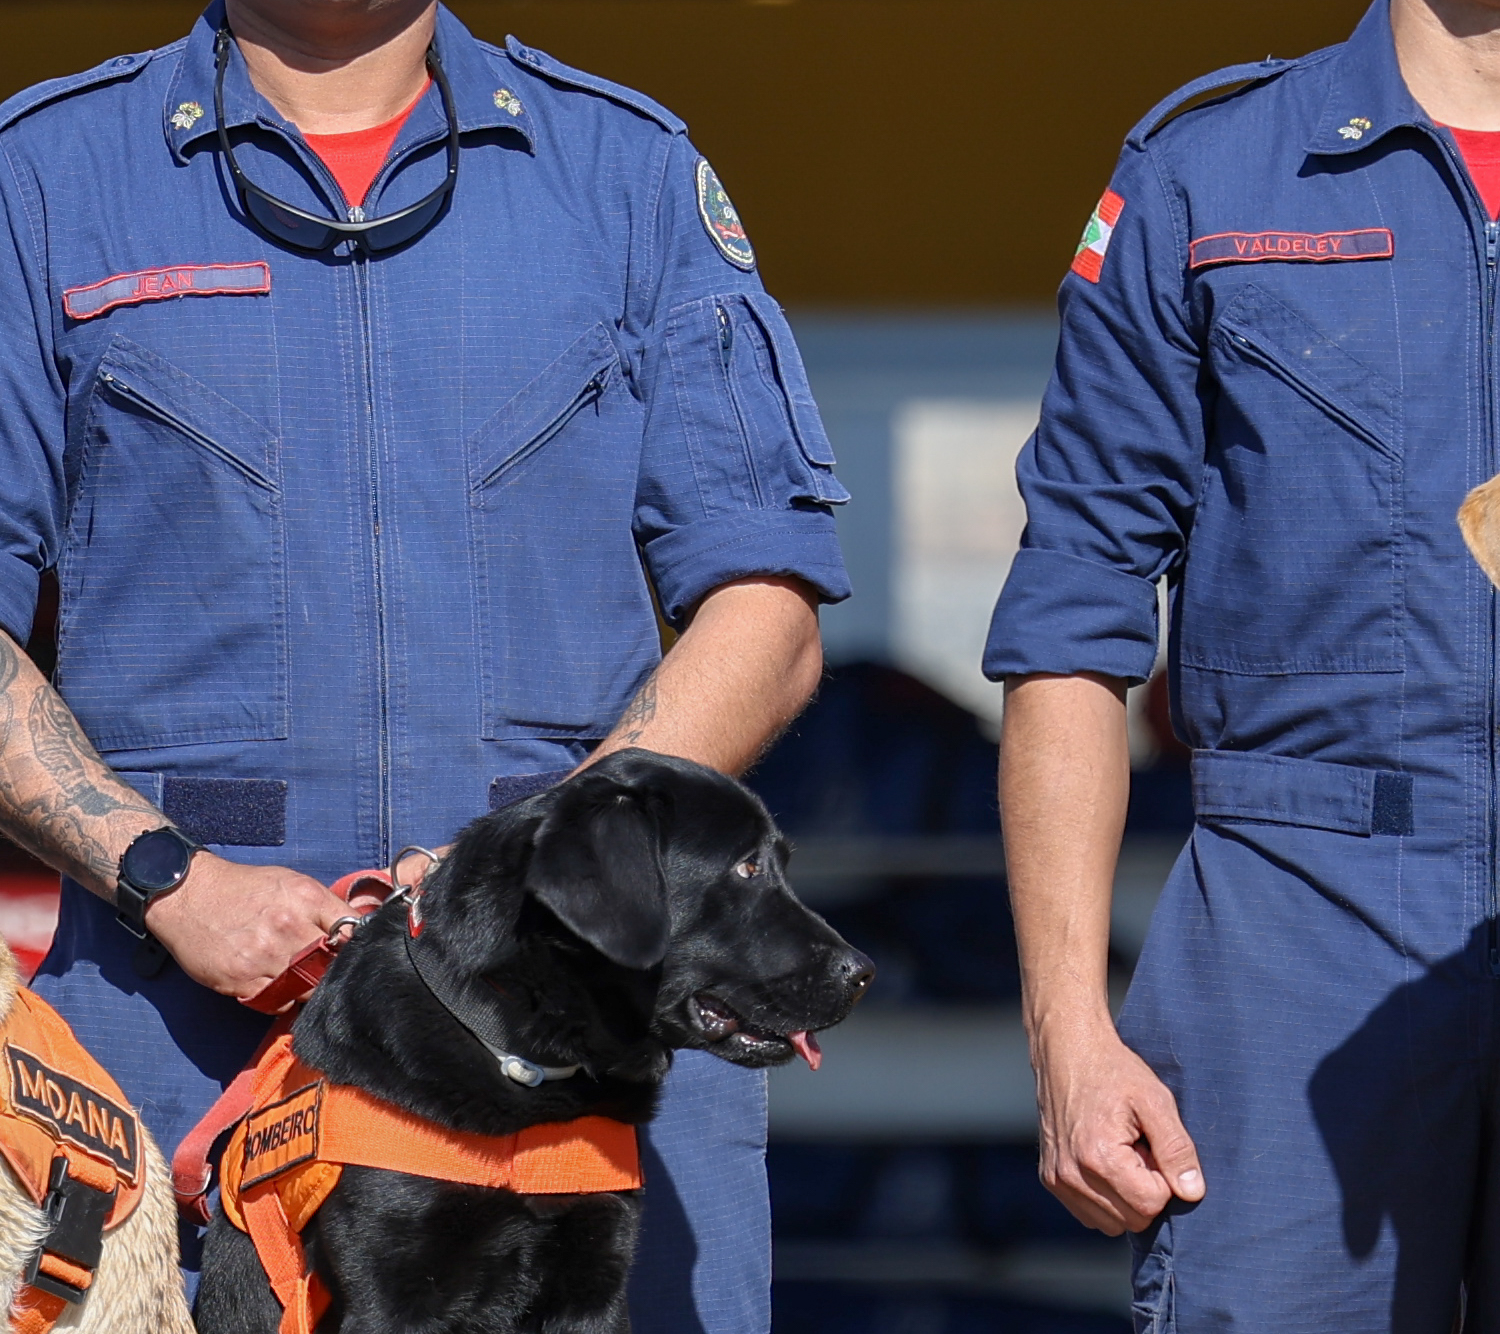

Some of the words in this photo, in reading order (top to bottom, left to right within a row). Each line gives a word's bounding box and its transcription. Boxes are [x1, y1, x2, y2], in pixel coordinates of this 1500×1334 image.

[1234, 238, 1342, 255] VALDELEY
[131, 273, 193, 296] JEAN
[17, 1060, 130, 1160] MOANA
